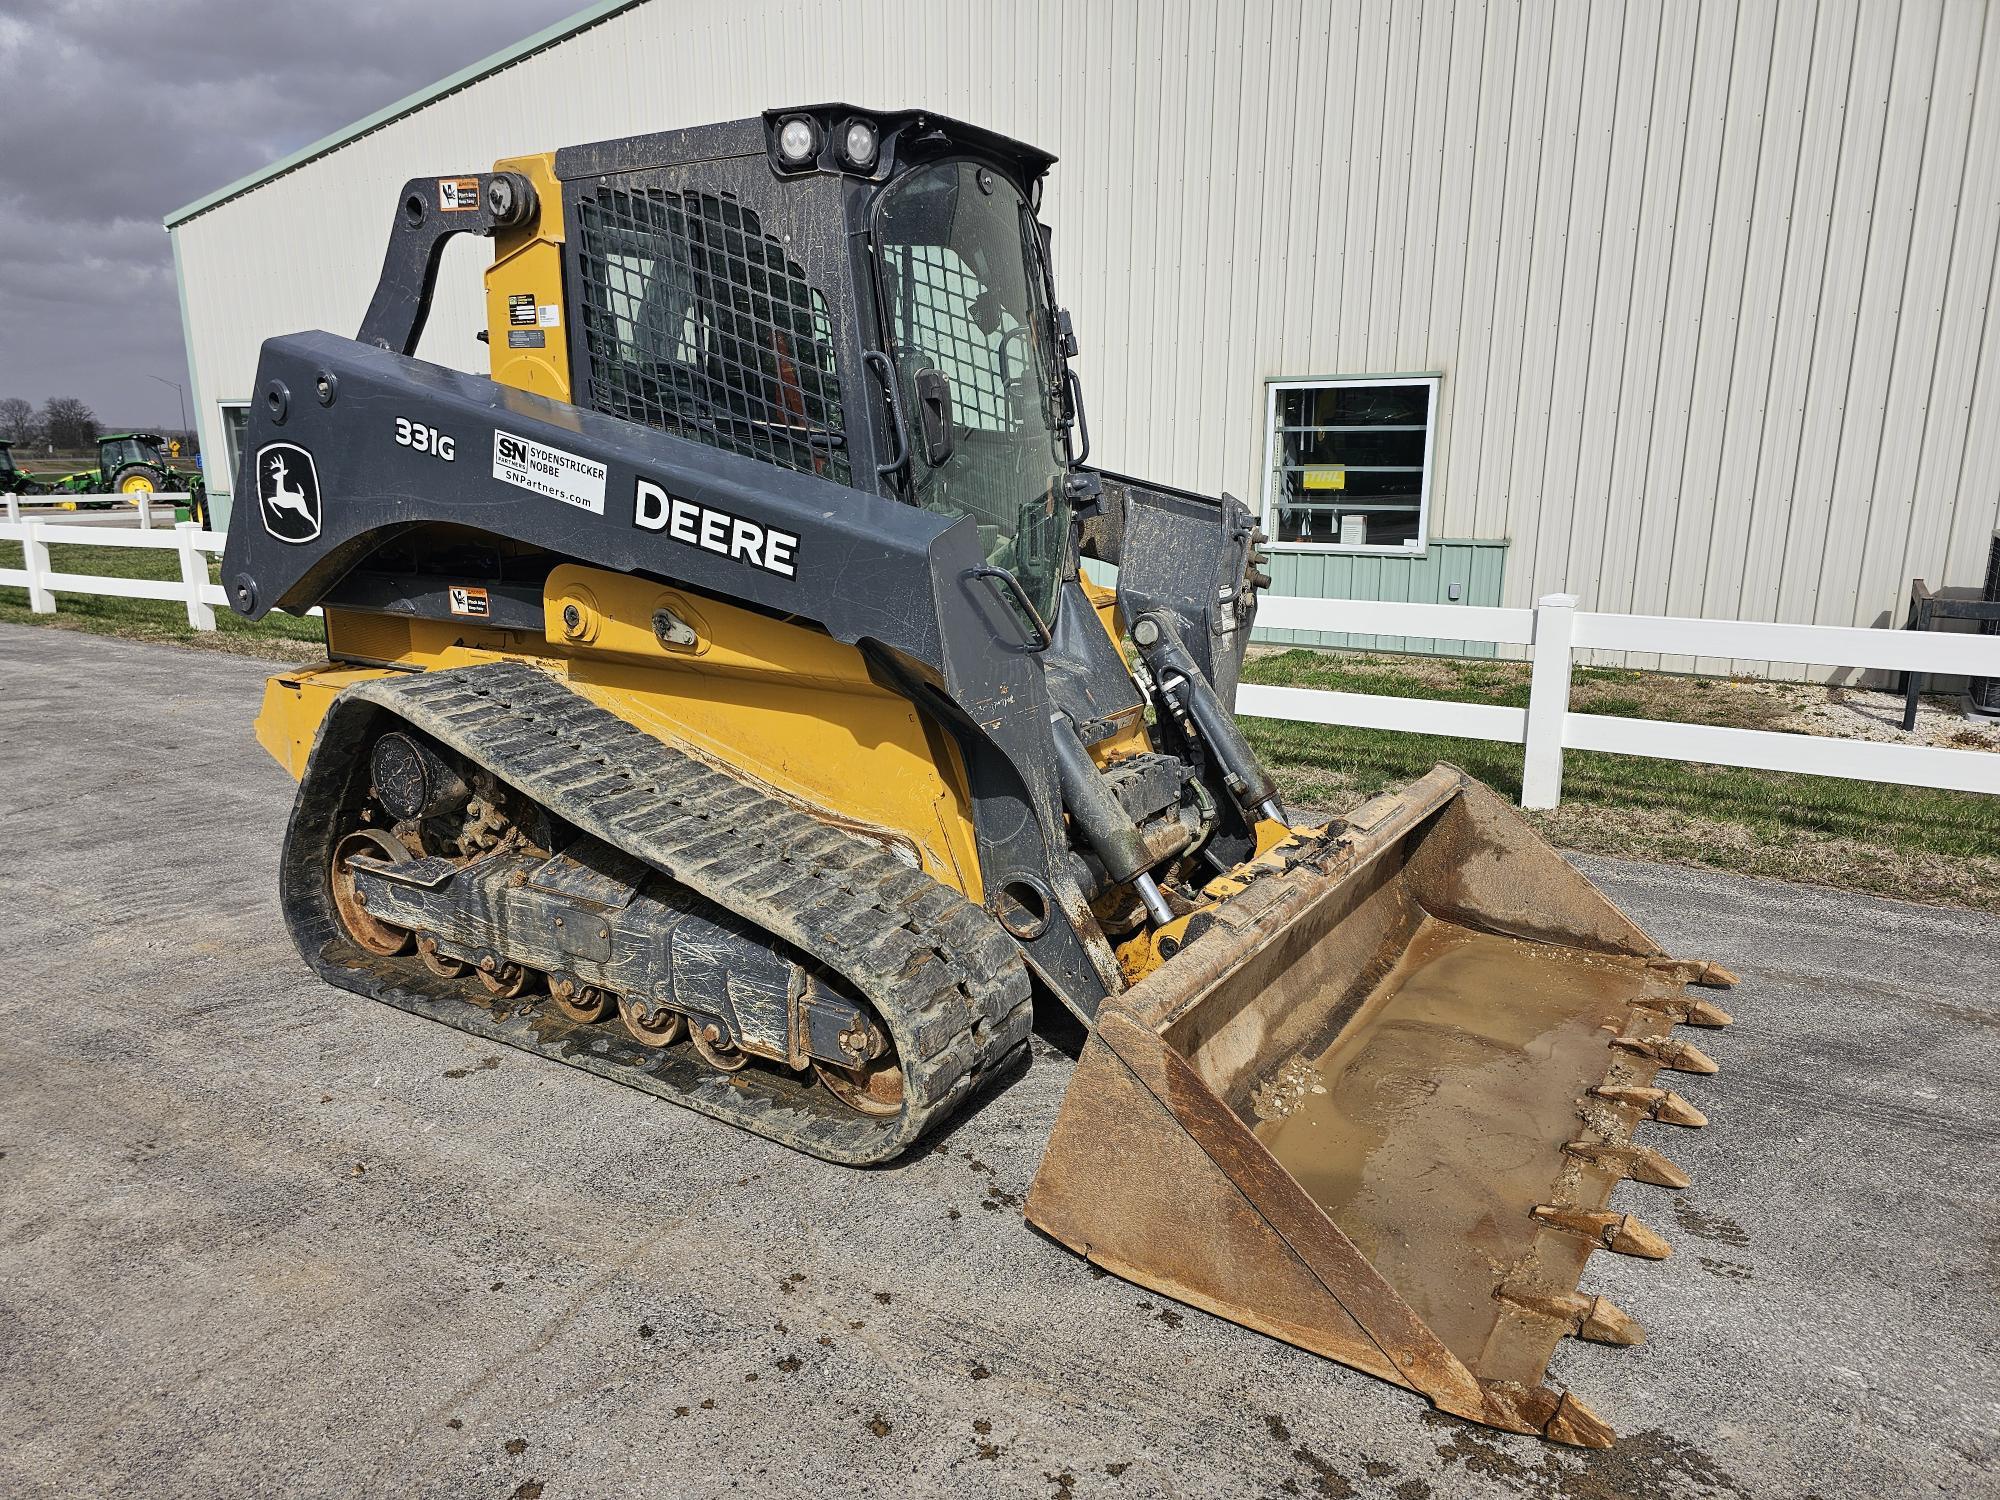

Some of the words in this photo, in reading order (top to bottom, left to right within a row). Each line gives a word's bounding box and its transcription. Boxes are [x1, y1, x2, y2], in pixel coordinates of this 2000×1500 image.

[395, 417, 456, 462] 331G
[499, 438, 526, 463] SN
[498, 457, 526, 470] PARTNERS
[530, 447, 605, 480] SYDENSTRICKER
[530, 460, 560, 477] NOBBE
[506, 470, 591, 507] SNPartners.com
[636, 479, 797, 576] DEERE
